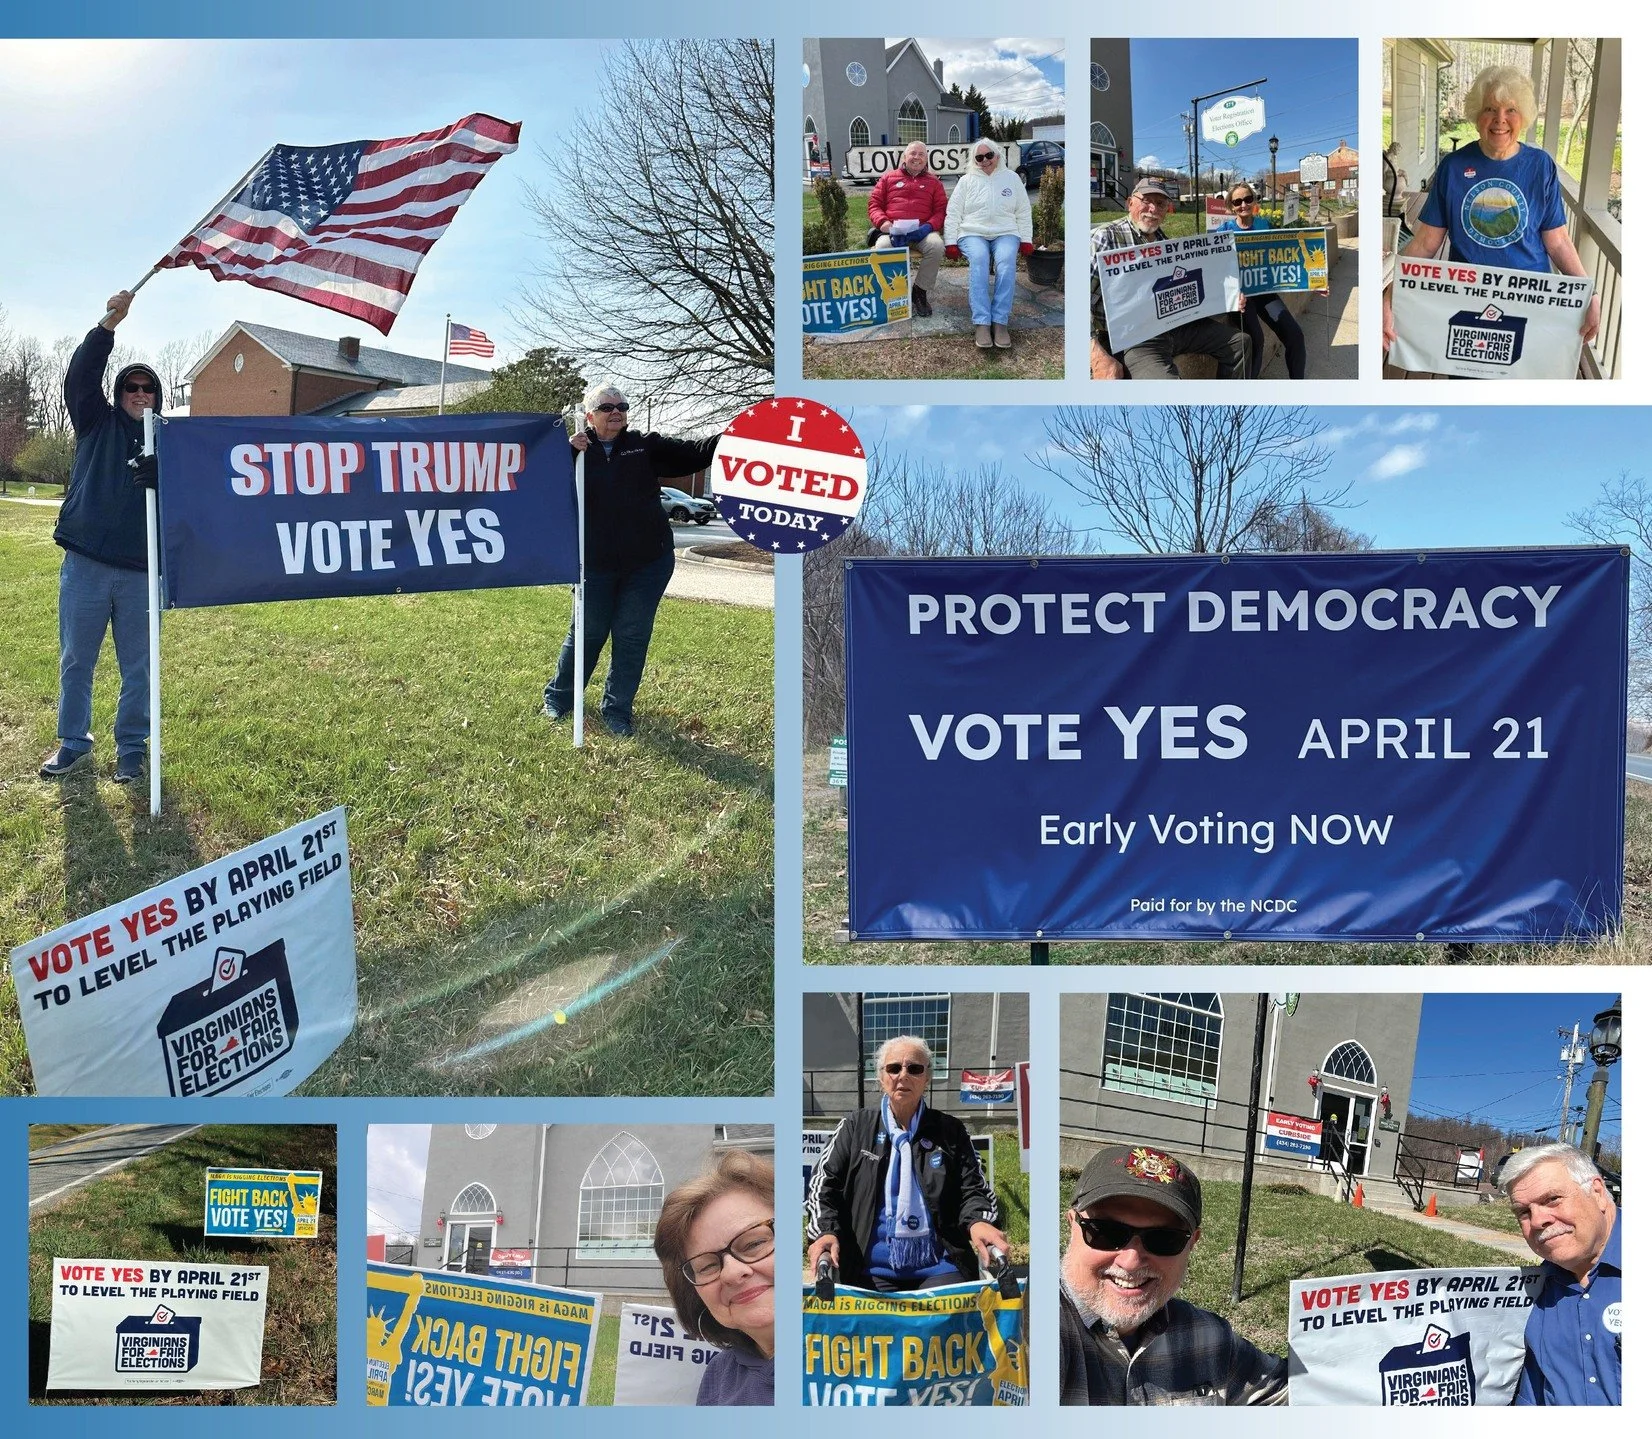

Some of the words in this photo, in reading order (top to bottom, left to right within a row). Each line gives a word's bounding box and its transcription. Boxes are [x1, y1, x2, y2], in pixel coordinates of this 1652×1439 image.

[1223, 108, 1254, 120] Registration
[1464, 181, 1493, 210] NELSON
[1499, 182, 1526, 212] COUNTY
[1103, 250, 1136, 266] VOTE
[1140, 246, 1162, 258] YES
[1166, 242, 1180, 254] BY
[1183, 237, 1211, 250] APRIL
[1214, 233, 1230, 245] 21ST
[1106, 268, 1120, 276] TO
[1123, 261, 1152, 273] LEVEL
[1155, 256, 1172, 266] THE
[1175, 250, 1208, 262] PLAYING
[1210, 245, 1232, 254] FIELD
[1269, 247, 1300, 264] BACK
[834, 258, 868, 268] ELECTIONS
[1271, 264, 1300, 284] YES!
[831, 274, 875, 298] BACK
[1401, 262, 1441, 279] VOTE
[1448, 267, 1476, 284] YES
[1482, 273, 1503, 286] BY
[1508, 276, 1552, 294] APRIL
[1557, 282, 1587, 295] 21ST
[1158, 284, 1196, 300] VIRGINIANS
[1160, 297, 1174, 308] FOR
[1182, 290, 1196, 300] FAIR
[1400, 279, 1416, 288] TO
[1420, 282, 1458, 294] LEVEL
[1464, 286, 1487, 298] THE
[1492, 290, 1544, 305] PLAYING
[1548, 297, 1582, 308] FIELD
[836, 297, 878, 324] YES!
[1160, 298, 1198, 315] ELECTIONS
[1452, 338, 1473, 348] FOR
[1487, 342, 1510, 352] FAIR
[1453, 328, 1512, 344] VIRGINIANS
[1451, 347, 1509, 361] ELECTIONS
[227, 442, 364, 496] STOP
[371, 441, 524, 492] TRUMP
[276, 519, 396, 575] VOTE
[405, 508, 506, 566] YES
[908, 591, 1166, 636] PROTECT
[1188, 585, 1562, 633] DEMOCRACY
[908, 713, 1082, 761] VOTE
[1104, 704, 1248, 761] YES
[1298, 716, 1471, 761] APRIL
[1492, 716, 1550, 760] 21
[1040, 814, 1136, 854] Early
[1148, 812, 1274, 854] Voting
[1290, 814, 1394, 845] NOW
[28, 925, 114, 982] VOTE
[120, 898, 178, 942] YES
[184, 876, 218, 916] BY
[228, 845, 297, 896] APRIL
[301, 820, 337, 861] 21ST
[1131, 898, 1166, 912] Paid
[1170, 899, 1192, 912] for
[1196, 899, 1215, 916] by
[1220, 899, 1245, 912] the
[1250, 900, 1298, 913] NCDC
[34, 984, 71, 1010] TO
[80, 948, 158, 997] LEVEL
[162, 922, 208, 957] THE
[213, 879, 294, 934] PLAYING
[298, 853, 342, 890] FIELD
[170, 988, 277, 1058] VIRGINIANS
[176, 1049, 219, 1078] FOR
[240, 1008, 281, 1043] FAIR
[180, 1028, 284, 1096] ELECTIONS
[1279, 1130, 1312, 1140] CURBSIDE
[210, 1188, 250, 1206] FIGHT
[252, 1189, 290, 1208] BACK
[210, 1208, 250, 1228] VOTE
[254, 1208, 288, 1228] YES!
[60, 1266, 105, 1282] VOTE
[112, 1268, 144, 1283] YES
[150, 1270, 172, 1284] BY
[178, 1270, 226, 1286] APRIL
[230, 1272, 261, 1286] 21ST
[60, 1285, 78, 1296] TO
[82, 1286, 125, 1298] LEVEL
[130, 1287, 156, 1298] THE
[162, 1288, 218, 1300] PLAYING
[222, 1290, 260, 1302] FIELD
[804, 1300, 836, 1311] MAGA
[840, 1298, 850, 1311] is
[854, 1299, 906, 1312] RIGGING
[911, 1296, 977, 1312] ELECTIONS
[1301, 1286, 1361, 1310] VOTE
[1369, 1280, 1410, 1302] YES
[1416, 1278, 1439, 1296] BY
[1446, 1276, 1500, 1292] APRIL
[1505, 1274, 1540, 1292] 21ST
[1300, 1316, 1324, 1332] TO
[1331, 1308, 1387, 1328] LEVEL
[1392, 1302, 1424, 1320] THE
[1430, 1296, 1490, 1314] PLAYING
[1493, 1296, 1534, 1308] FIELD
[122, 1336, 187, 1348] VIRGINIANS
[122, 1348, 145, 1358] FOR
[159, 1348, 186, 1358] FAIR
[121, 1358, 186, 1368] ELECTIONS
[805, 1333, 894, 1380] FIGHT
[902, 1331, 986, 1381] BACK
[1388, 1364, 1468, 1390] VIRGINIANS
[1390, 1388, 1420, 1406] FOR
[1438, 1380, 1469, 1398] FAIR
